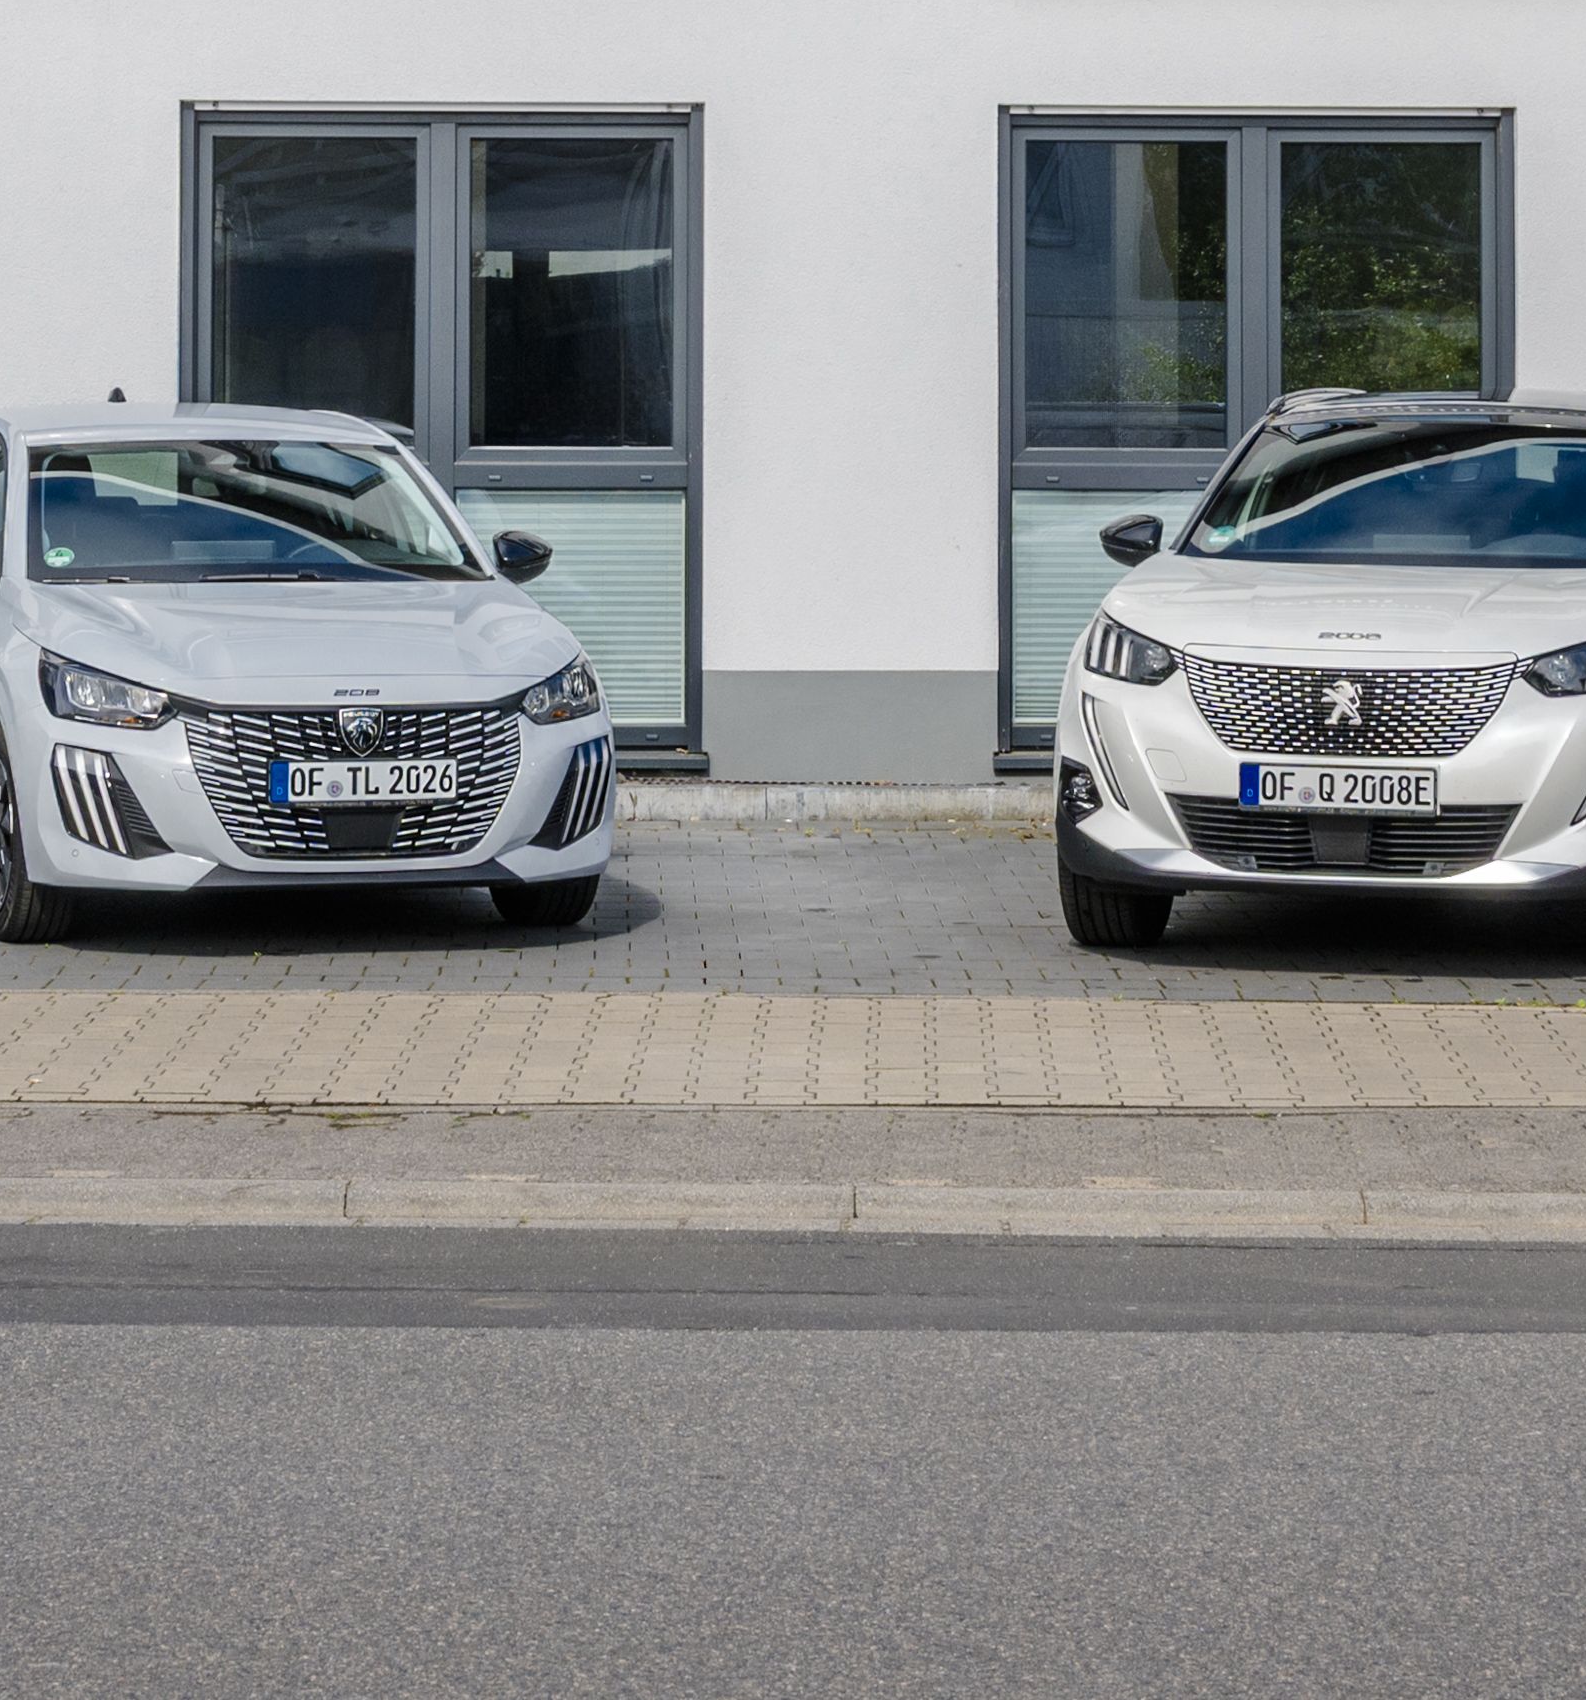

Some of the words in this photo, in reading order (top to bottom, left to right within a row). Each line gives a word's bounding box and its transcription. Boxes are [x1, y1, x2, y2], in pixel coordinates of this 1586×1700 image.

[333, 689, 380, 697] 208
[290, 767, 325, 797] OF
[347, 766, 380, 796] TL
[389, 764, 454, 795] 2026
[1262, 771, 1296, 801] OF
[1319, 773, 1335, 802] Q
[1343, 773, 1431, 806] 2008E
